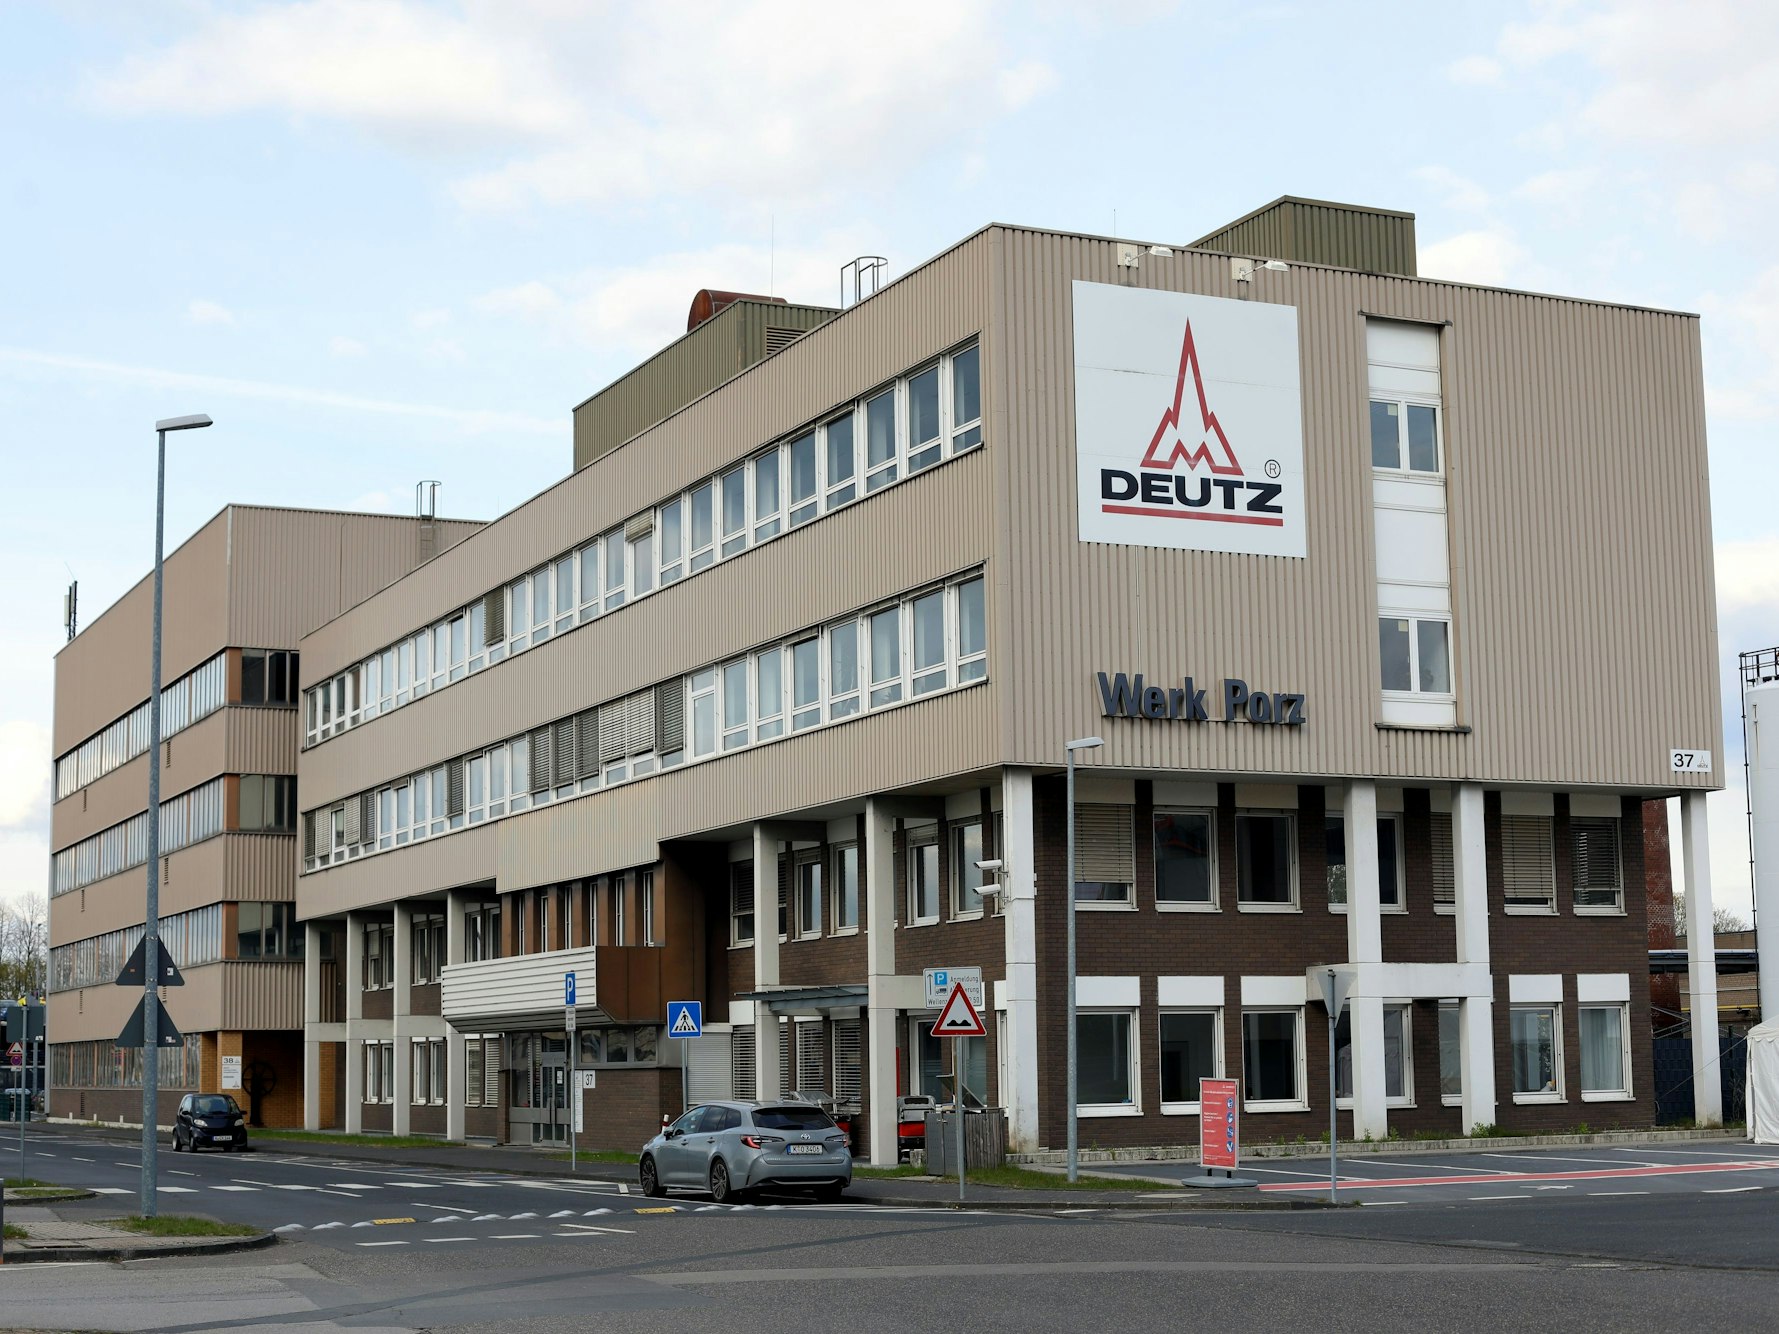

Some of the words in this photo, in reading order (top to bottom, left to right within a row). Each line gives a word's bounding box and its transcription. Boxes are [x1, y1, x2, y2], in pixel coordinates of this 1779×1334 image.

[1101, 468, 1283, 514] DEUTZ
[1096, 671, 1209, 720] Werk
[1222, 678, 1306, 724] Porz
[1674, 753, 1694, 768] 37
[567, 976, 574, 1001] P
[937, 973, 945, 984] P
[585, 1073, 594, 1086] 37
